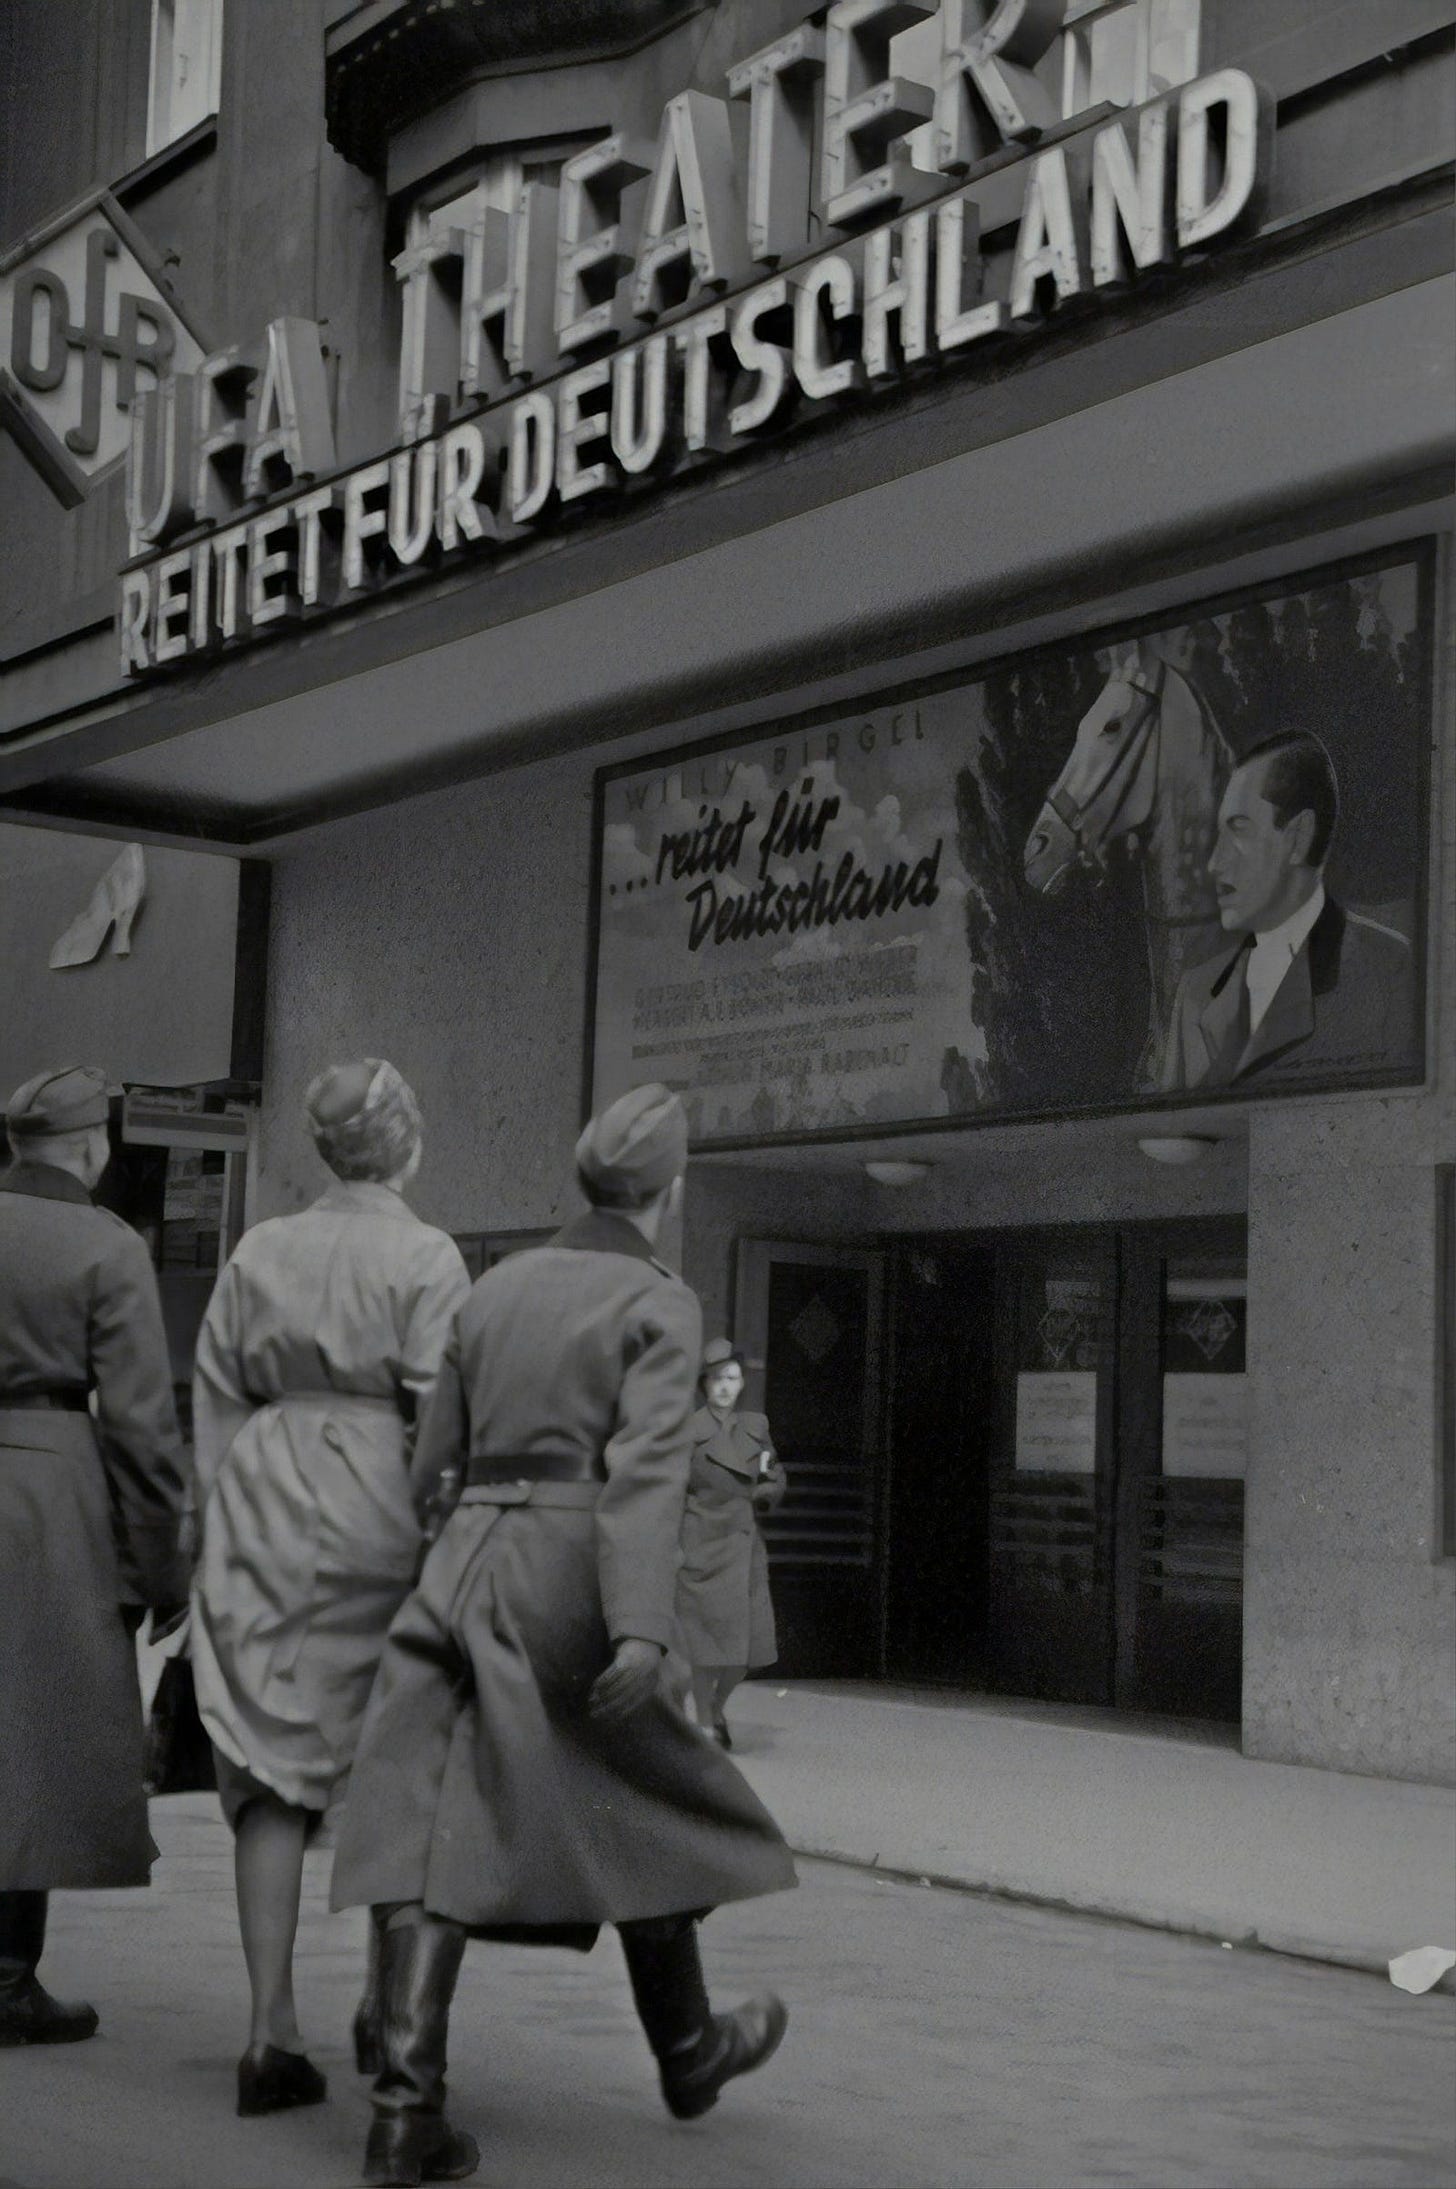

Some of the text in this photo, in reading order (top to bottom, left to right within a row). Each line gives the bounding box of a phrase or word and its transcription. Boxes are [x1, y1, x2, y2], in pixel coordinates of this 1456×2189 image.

[127, 0, 1032, 547] UFA THEATER
[120, 488, 332, 678] REITET
[511, 68, 1258, 524] DEUTSCHLAND
[772, 709, 925, 777] BIRGEL
[757, 775, 842, 881] für
[684, 837, 944, 953] Deutschland
